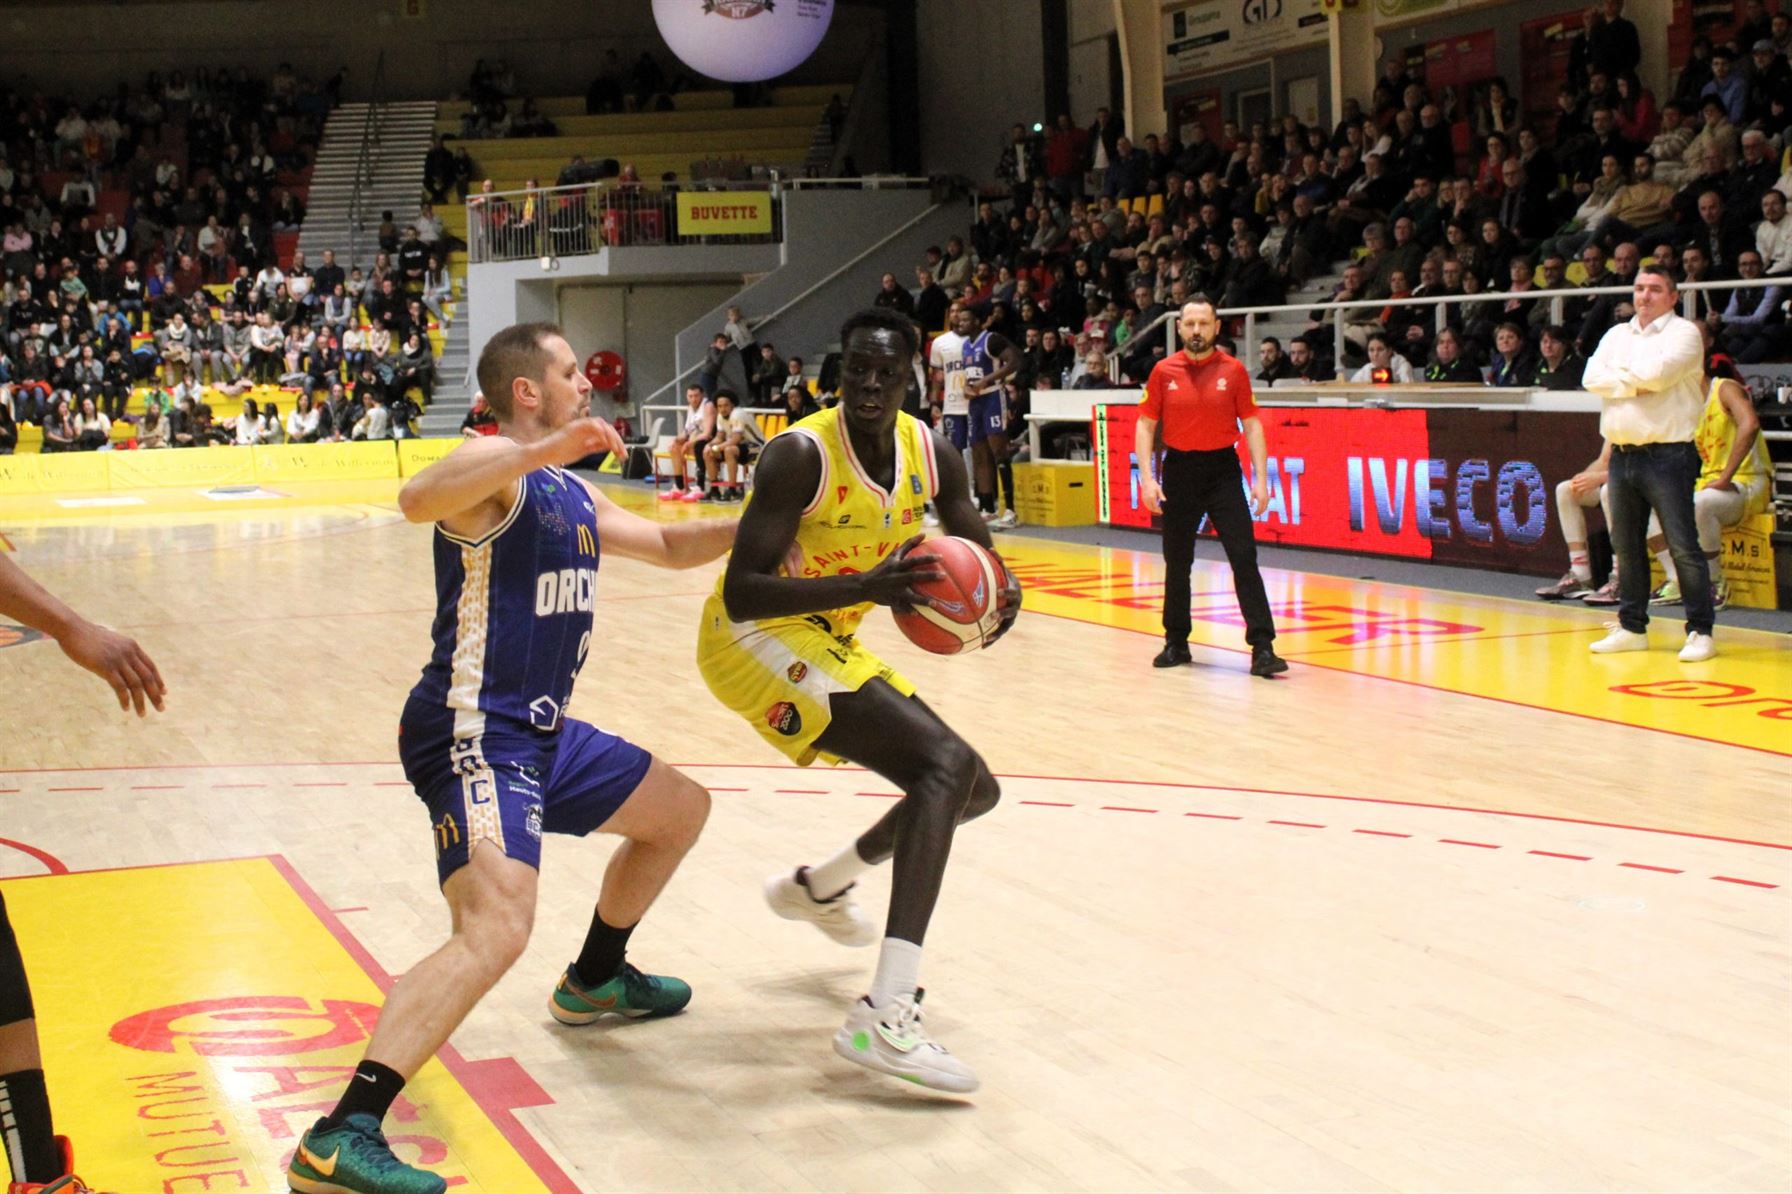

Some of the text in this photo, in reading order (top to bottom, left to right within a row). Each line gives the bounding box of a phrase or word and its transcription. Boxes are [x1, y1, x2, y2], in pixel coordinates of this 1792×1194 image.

[691, 206, 758, 220] BUVETTE
[990, 415, 1001, 428] 13
[1347, 456, 1548, 545] IVECO
